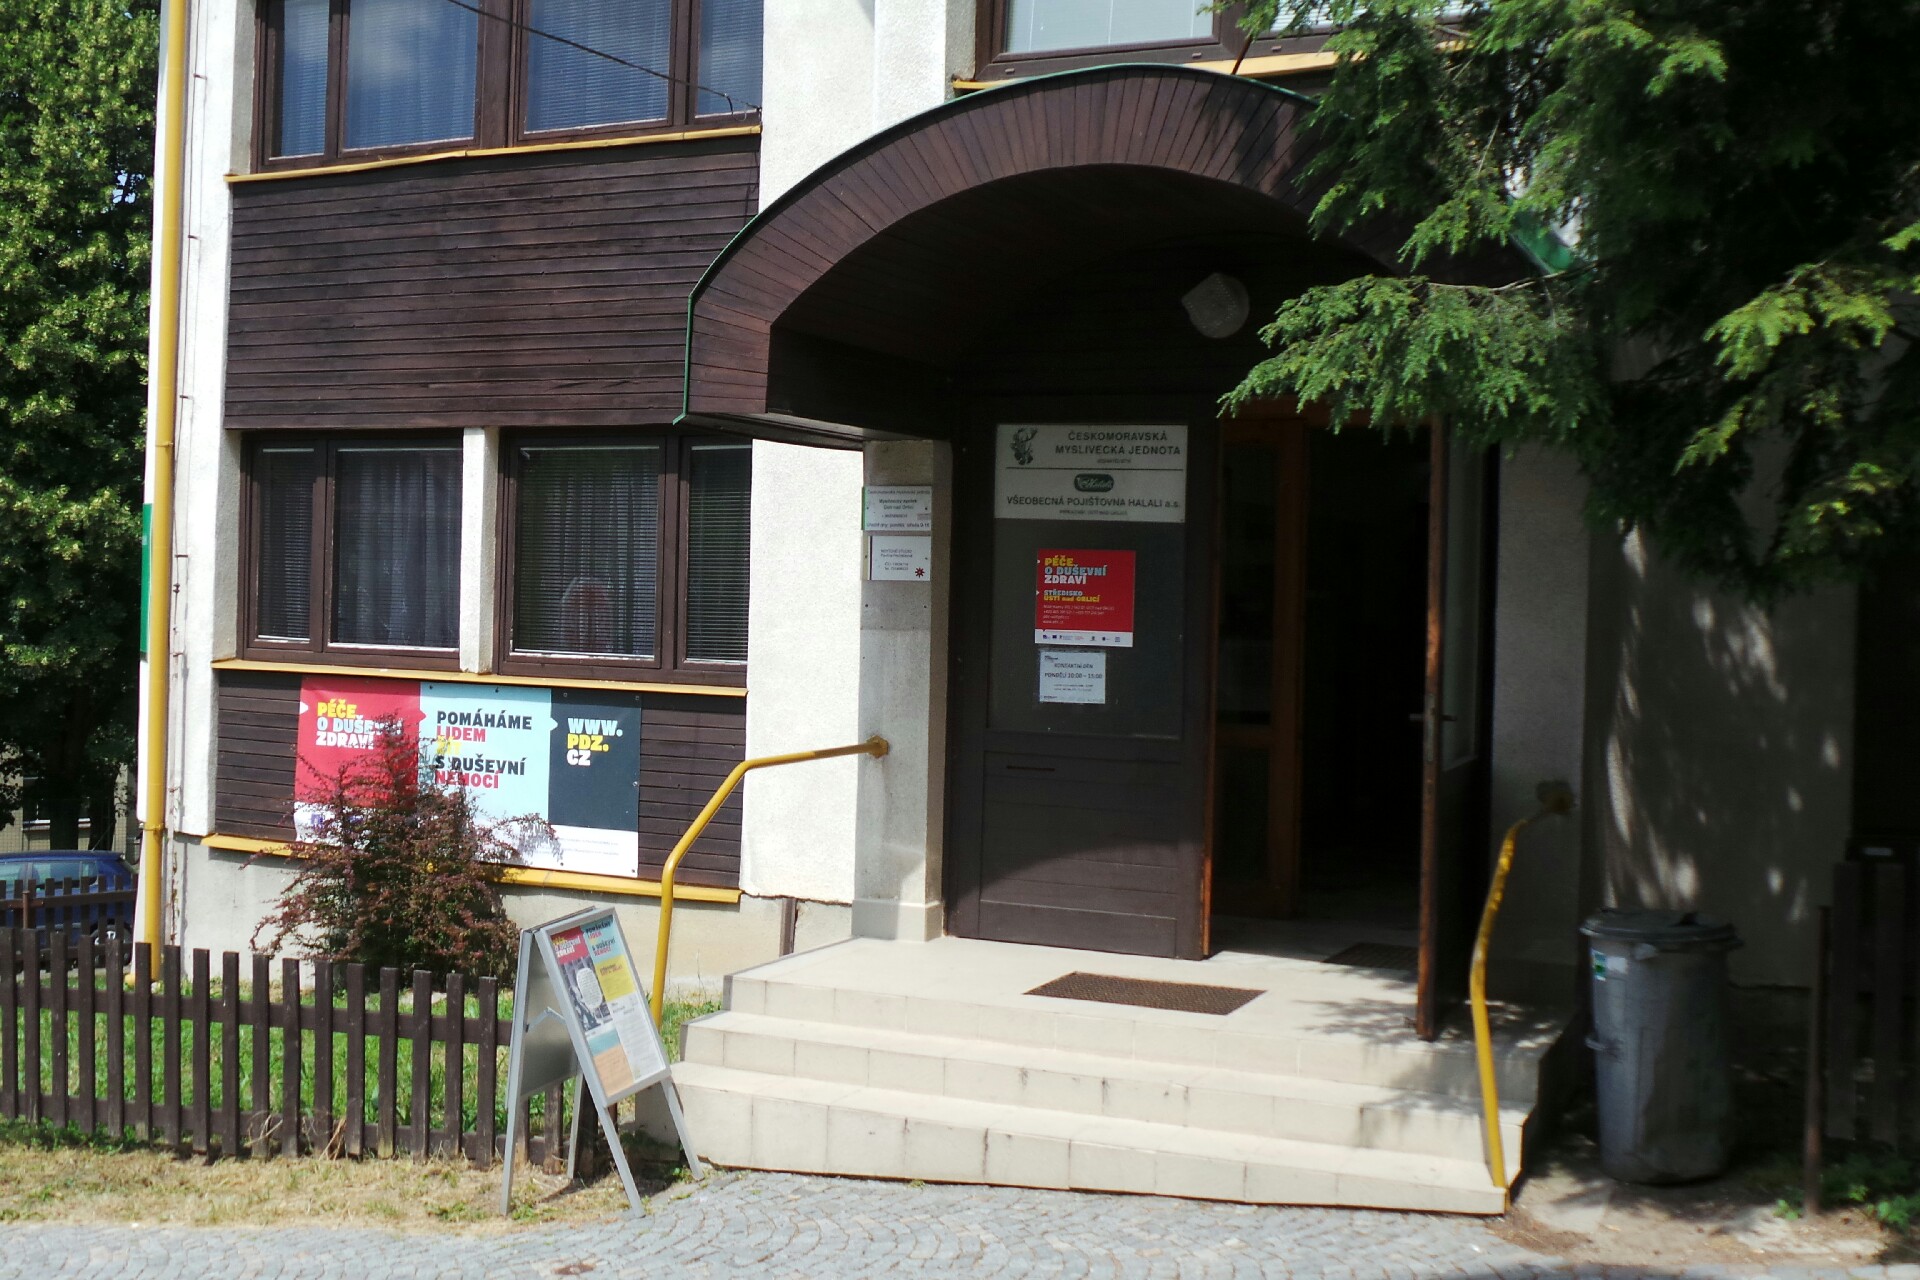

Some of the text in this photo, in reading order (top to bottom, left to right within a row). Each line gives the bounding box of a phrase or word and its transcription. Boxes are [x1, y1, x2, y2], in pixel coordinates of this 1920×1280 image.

[1068, 430, 1167, 441] ČESKOMORAVSKÁ
[1129, 446, 1181, 455] JEDNOTA
[1007, 495, 1064, 506] VŠEOBECNÁ
[1128, 499, 1162, 508] HALALI
[1044, 555, 1073, 567] PÉČE
[1044, 564, 1108, 576] O DUŠEVNÍ
[1044, 573, 1087, 584] ZDRAVÍ
[317, 699, 357, 719] PÉČE
[317, 717, 328, 731] O
[437, 708, 532, 730] POMÁHÁME
[437, 725, 486, 742] LIDEM
[567, 717, 623, 737] WWW.
[566, 733, 610, 753] PDZ.
[435, 753, 527, 775] S DUŠEVNÍ
[566, 750, 591, 767] CZ
